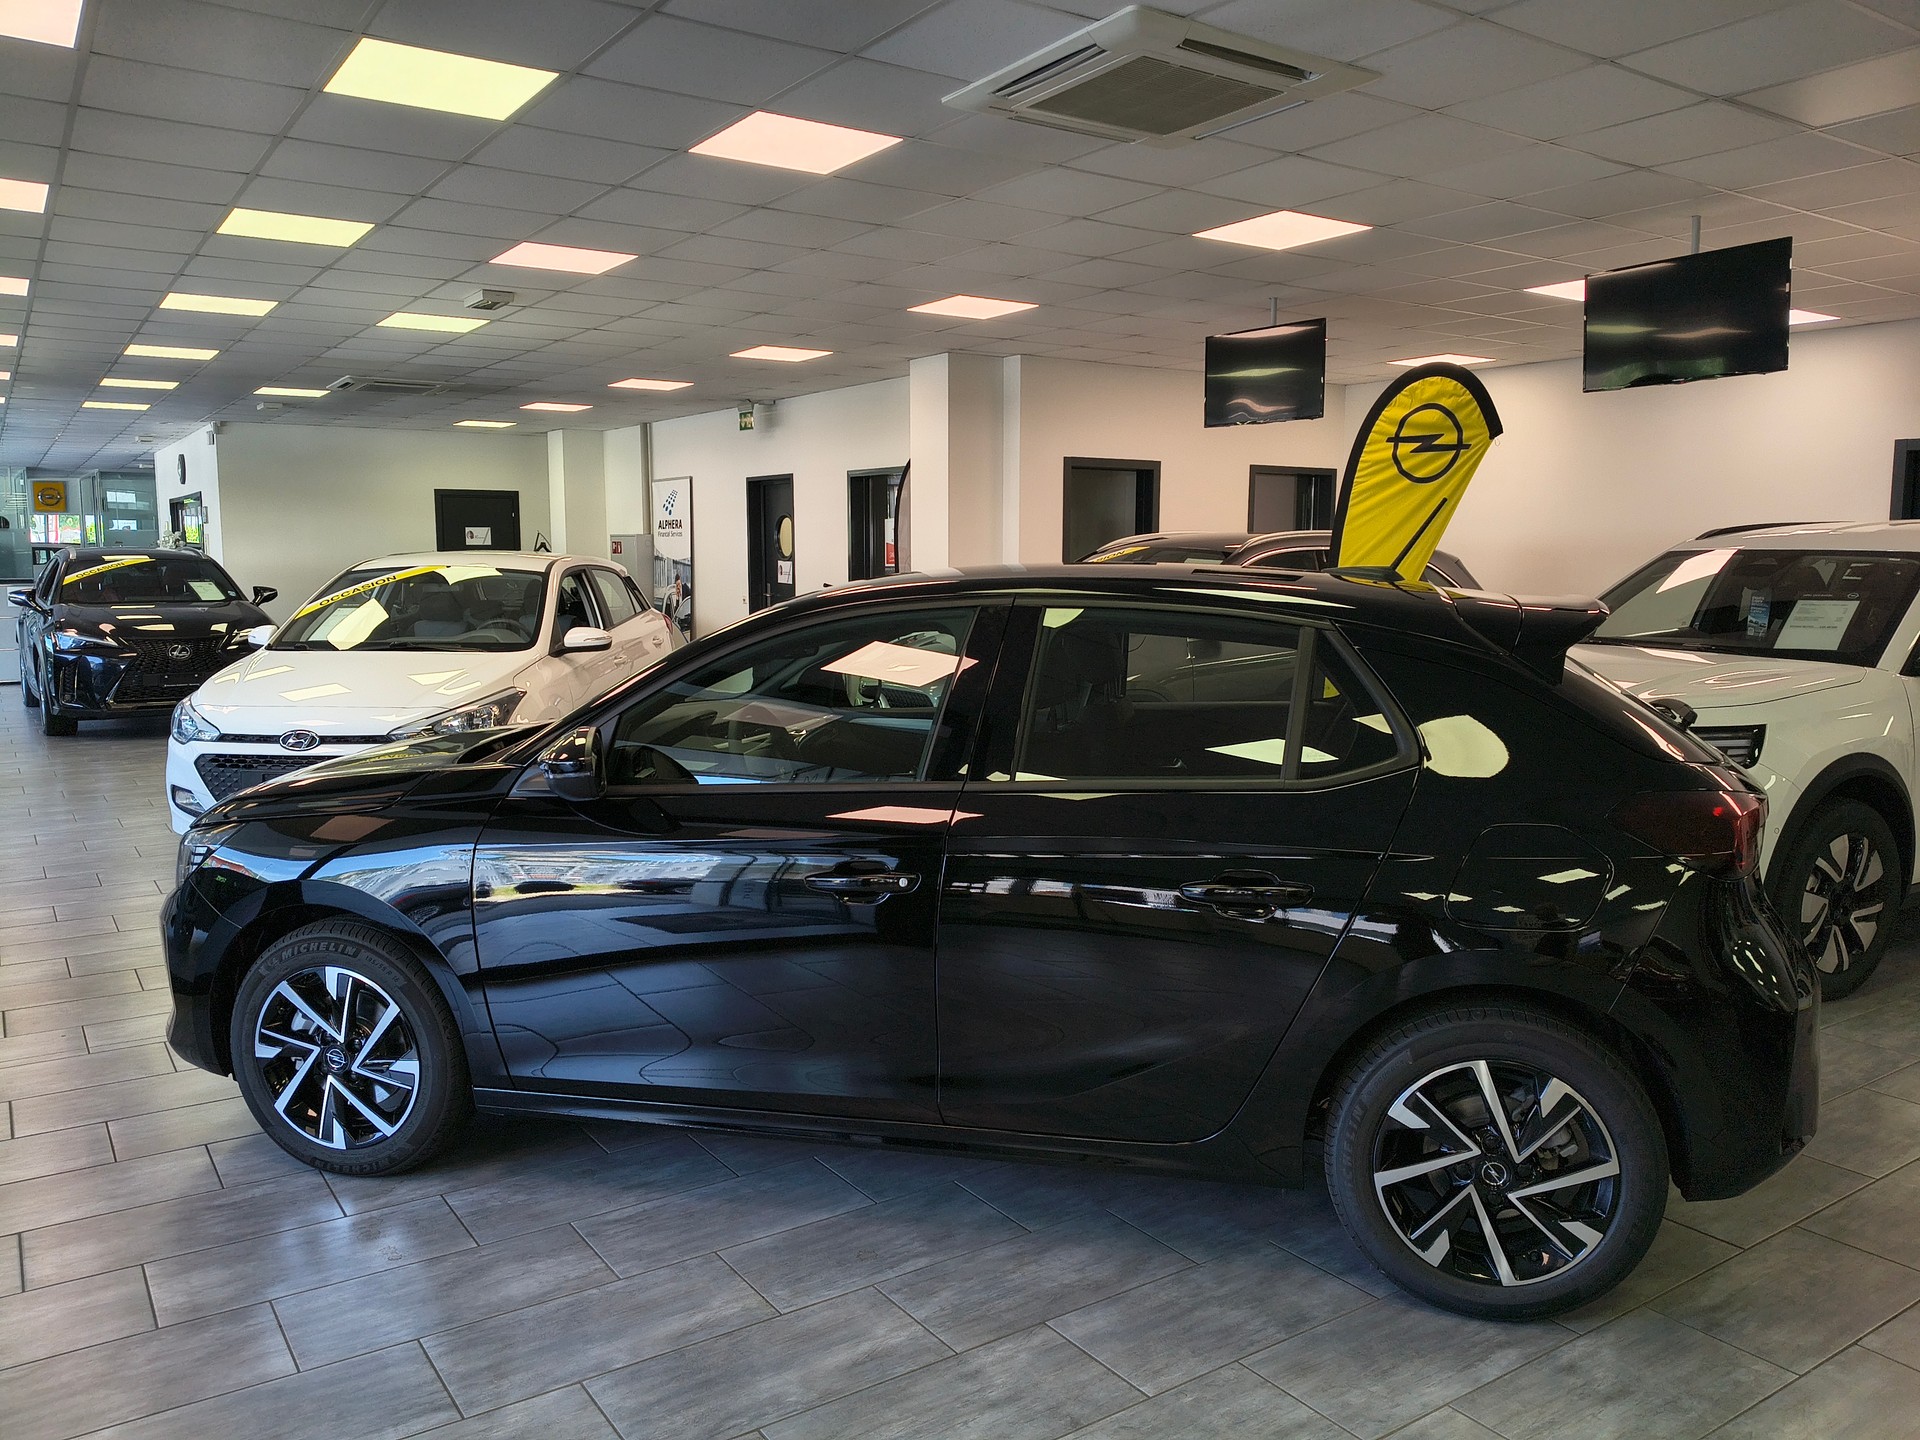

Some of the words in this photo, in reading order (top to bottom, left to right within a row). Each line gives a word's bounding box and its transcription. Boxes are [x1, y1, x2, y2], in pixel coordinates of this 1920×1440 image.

[658, 519, 682, 529] ALPHERA
[76, 562, 125, 579] OCCASION
[320, 575, 397, 606] OCCASION
[281, 942, 358, 960] MICHELIN
